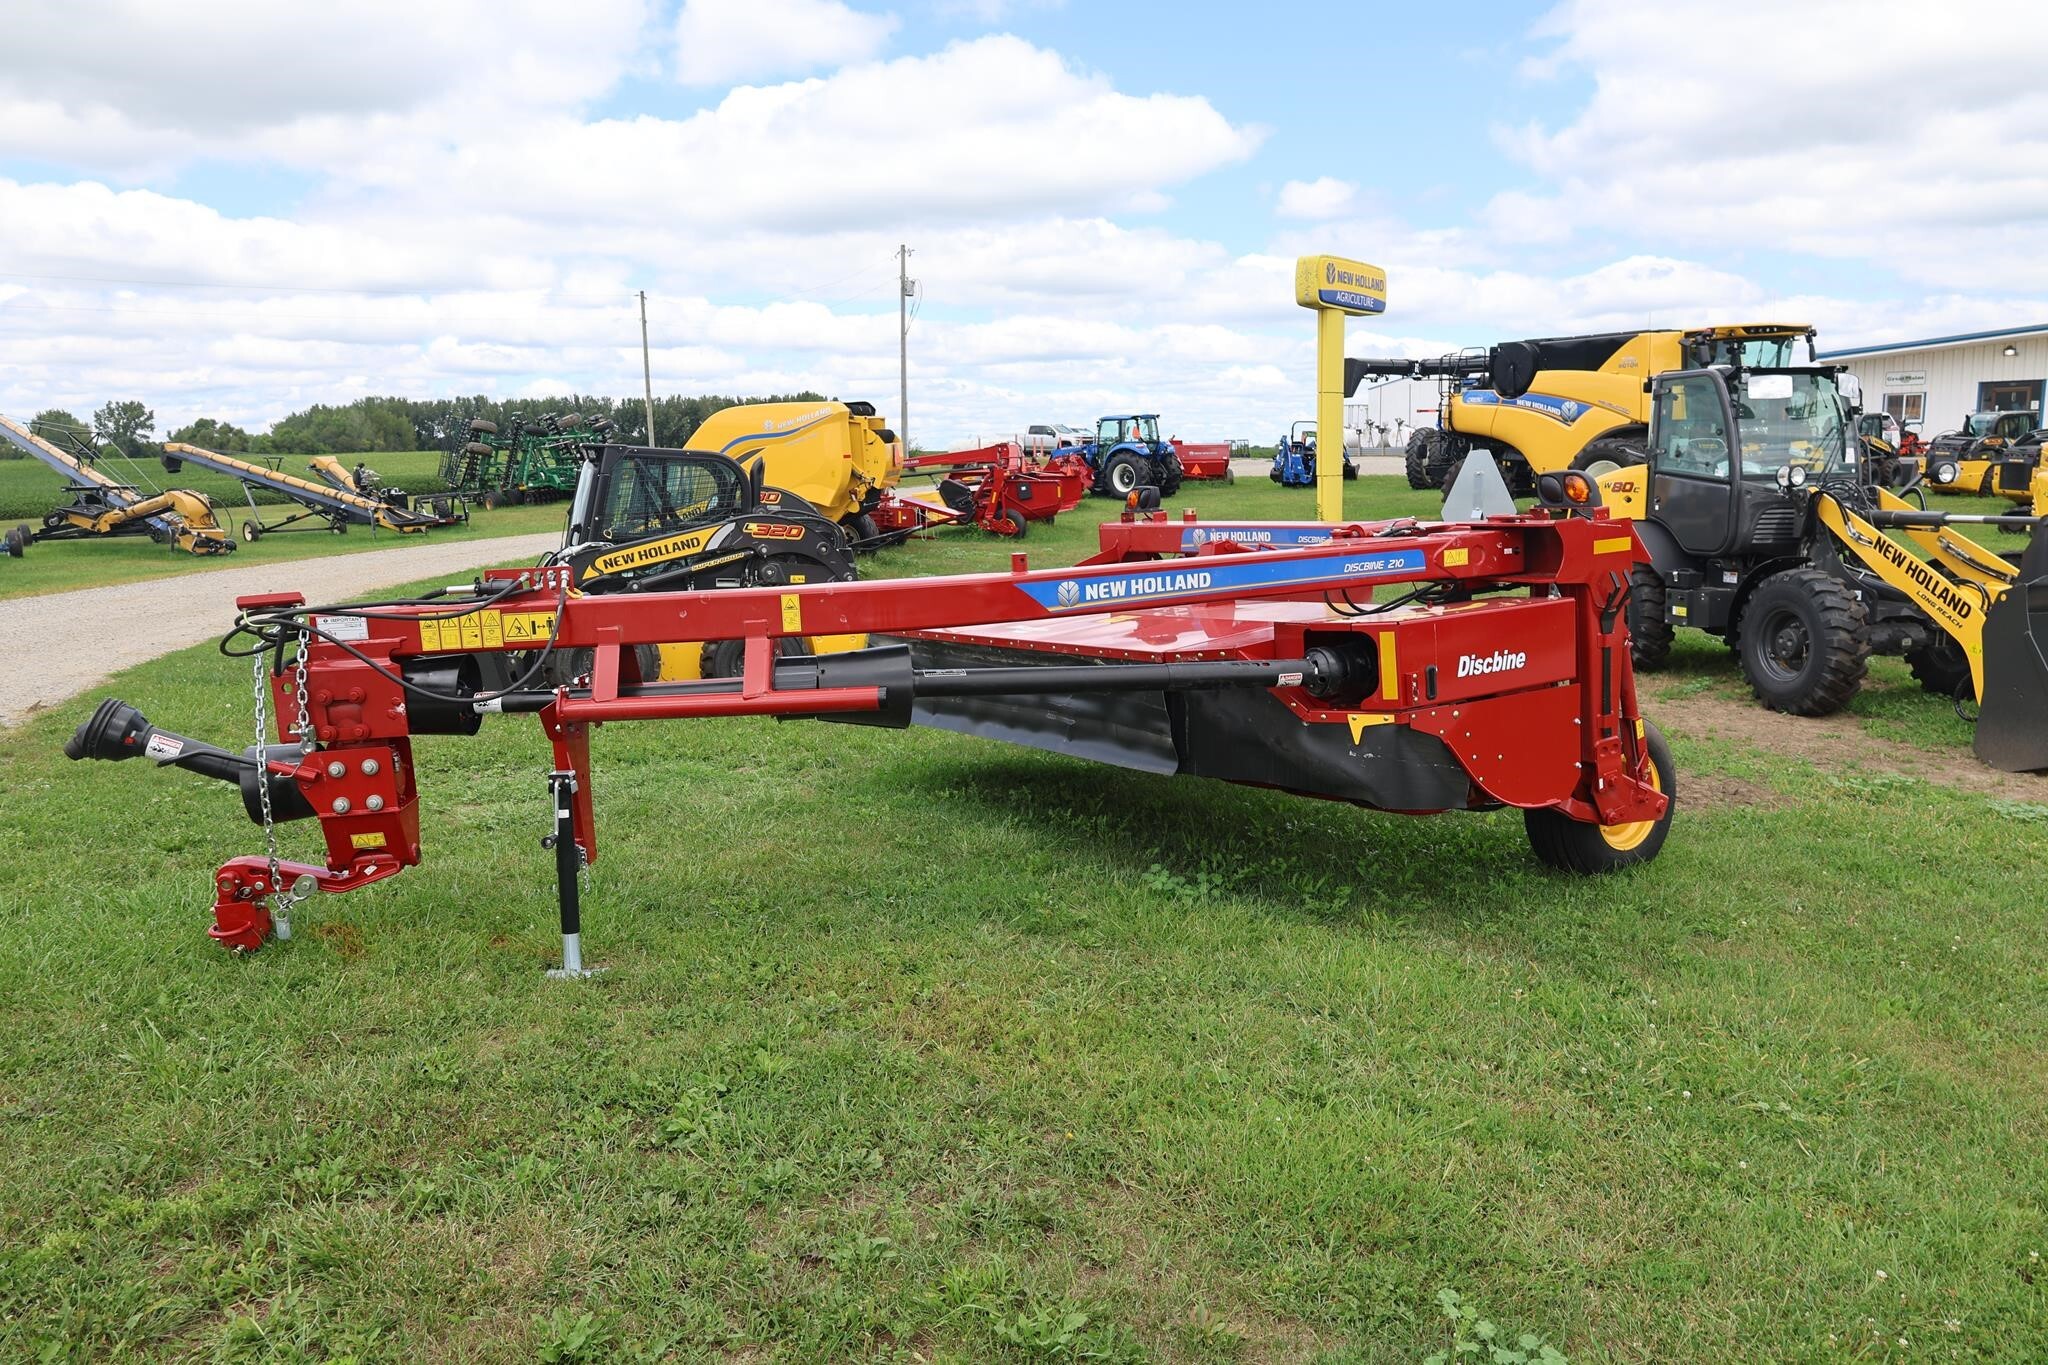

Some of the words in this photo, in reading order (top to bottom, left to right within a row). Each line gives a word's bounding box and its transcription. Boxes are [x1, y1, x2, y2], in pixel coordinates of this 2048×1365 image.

[1337, 270, 1354, 285] NEW
[1355, 274, 1384, 292] HOLLAND
[1336, 291, 1374, 308] AGRICULTURE
[795, 406, 833, 424] HOLLAND
[1516, 399, 1532, 409] NEW
[1532, 401, 1561, 416] HOLLAND
[743, 523, 805, 540] L320
[1210, 530, 1229, 542] NEW
[1230, 531, 1271, 543] HOLLAND
[602, 553, 636, 570] NEW
[638, 536, 701, 561] HOLLAND
[691, 560, 719, 572] SUPER
[1343, 560, 1384, 573] DISCBINE
[1387, 558, 1405, 569] 210
[1873, 535, 1907, 568] NEW
[1904, 560, 1972, 619] HOLLAND
[1085, 580, 1127, 601] NEW
[1130, 572, 1211, 595] HOLLAND
[1916, 590, 1938, 608] LONG
[1938, 606, 1963, 628] REACH
[1457, 649, 1526, 678] Discbine
